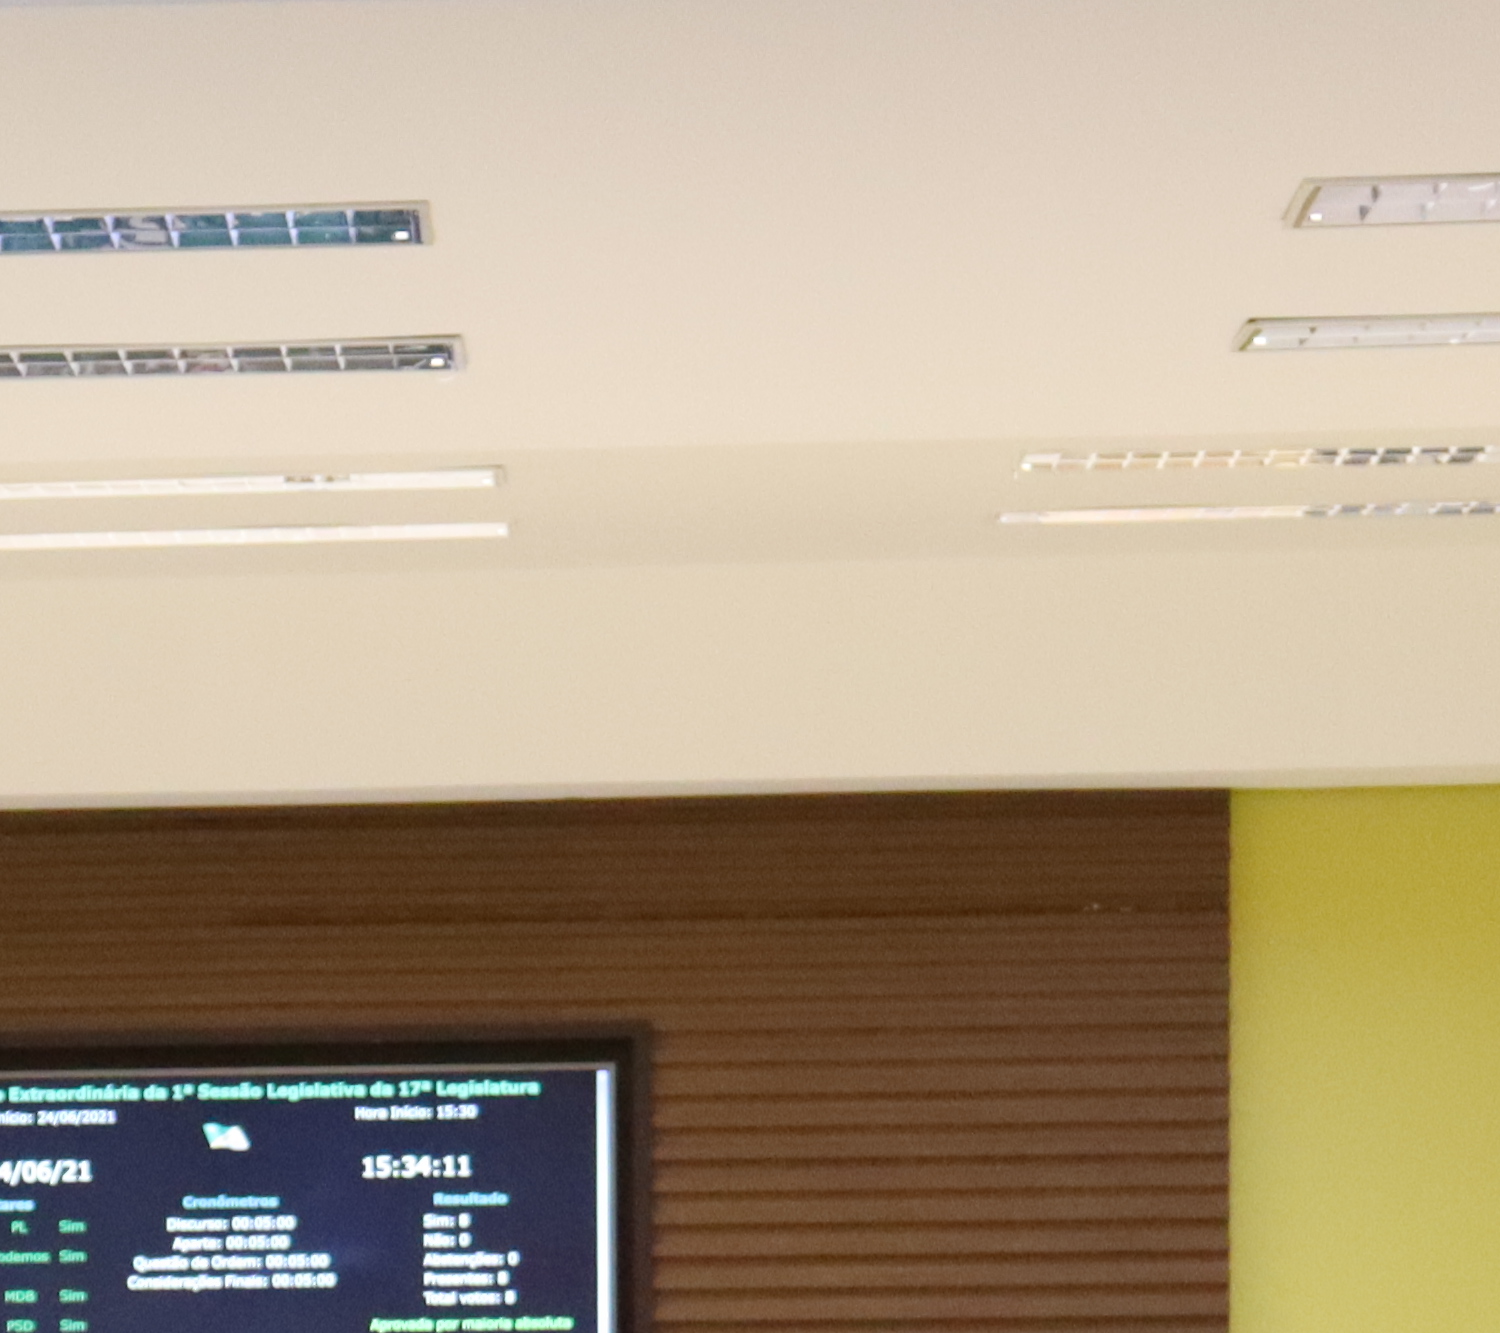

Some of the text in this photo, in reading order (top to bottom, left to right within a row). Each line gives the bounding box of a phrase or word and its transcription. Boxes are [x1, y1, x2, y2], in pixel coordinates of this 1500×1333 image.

[8, 1084, 141, 1102] Extraordinária
[143, 1086, 169, 1101] da
[197, 1083, 263, 1100] Sessão
[267, 1081, 368, 1101] Legislativa
[369, 1081, 394, 1098] da
[436, 1080, 541, 1099] Legislatura
[36, 1109, 117, 1126] 24/06/2021
[354, 1104, 479, 1120] Hora Início: 15:30
[361, 1154, 472, 1179] 15:34:11
[433, 1192, 510, 1206] Resultado
[11, 1220, 29, 1234] PL
[59, 1219, 87, 1233] Sim
[166, 1215, 297, 1232] Discurso: 00:05:00
[423, 1212, 456, 1229] Sim:
[172, 1234, 292, 1253] Aparte: 00:05:00
[459, 1231, 472, 1248] 0
[59, 1249, 87, 1263] Sim
[133, 1254, 189, 1273] Questão
[211, 1254, 263, 1270] Ordem:
[265, 1252, 331, 1269] 00:05:00
[507, 1250, 520, 1267] 0
[127, 1272, 338, 1292] Considerações Finais: 00:05:00
[4, 1290, 39, 1303] MDB
[59, 1289, 88, 1303] Sim
[423, 1290, 458, 1306] Total
[6, 1319, 37, 1333] PSD
[60, 1319, 88, 1332] Sim
[436, 1318, 461, 1333] por
[462, 1317, 514, 1331] maioria
[515, 1315, 575, 1331] absoluta
